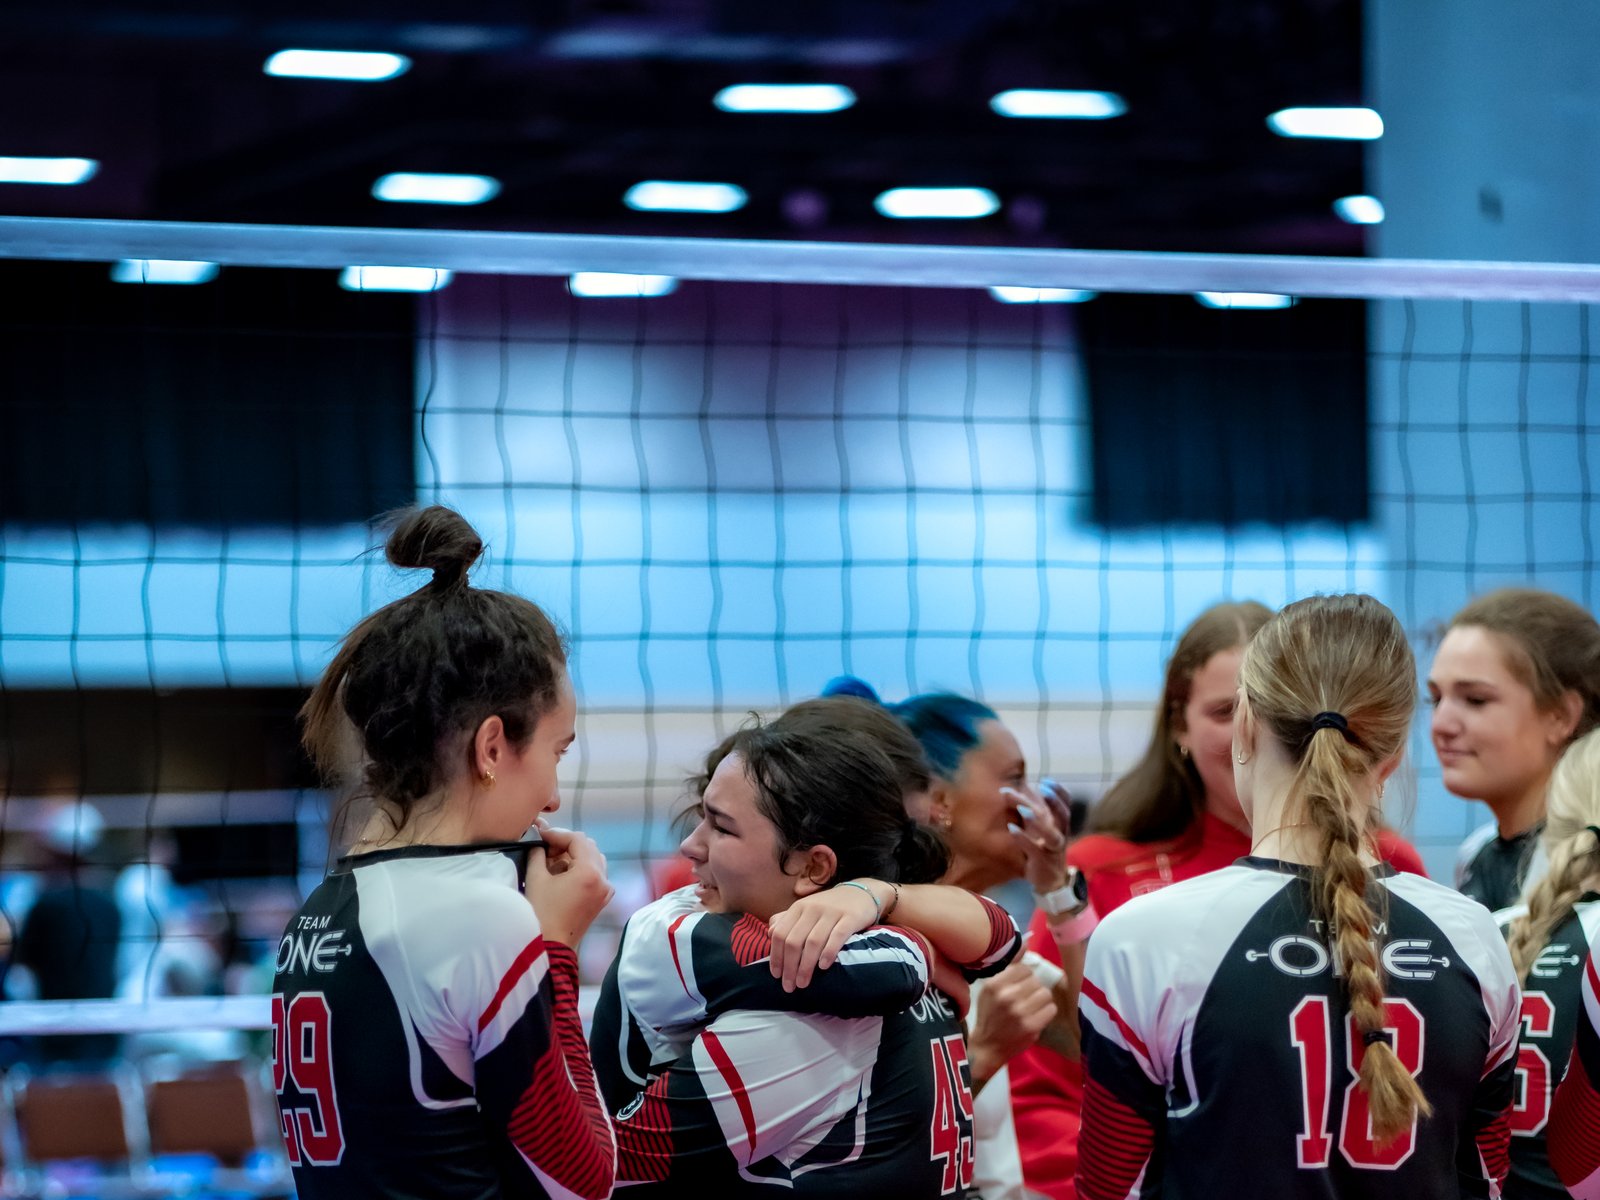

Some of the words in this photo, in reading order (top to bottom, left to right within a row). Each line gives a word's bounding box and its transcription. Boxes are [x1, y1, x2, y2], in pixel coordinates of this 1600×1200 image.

[275, 931, 345, 975] ONE
[297, 915, 331, 931] TEAM
[930, 1033, 975, 1195] 45
[1289, 995, 1425, 1170] 18
